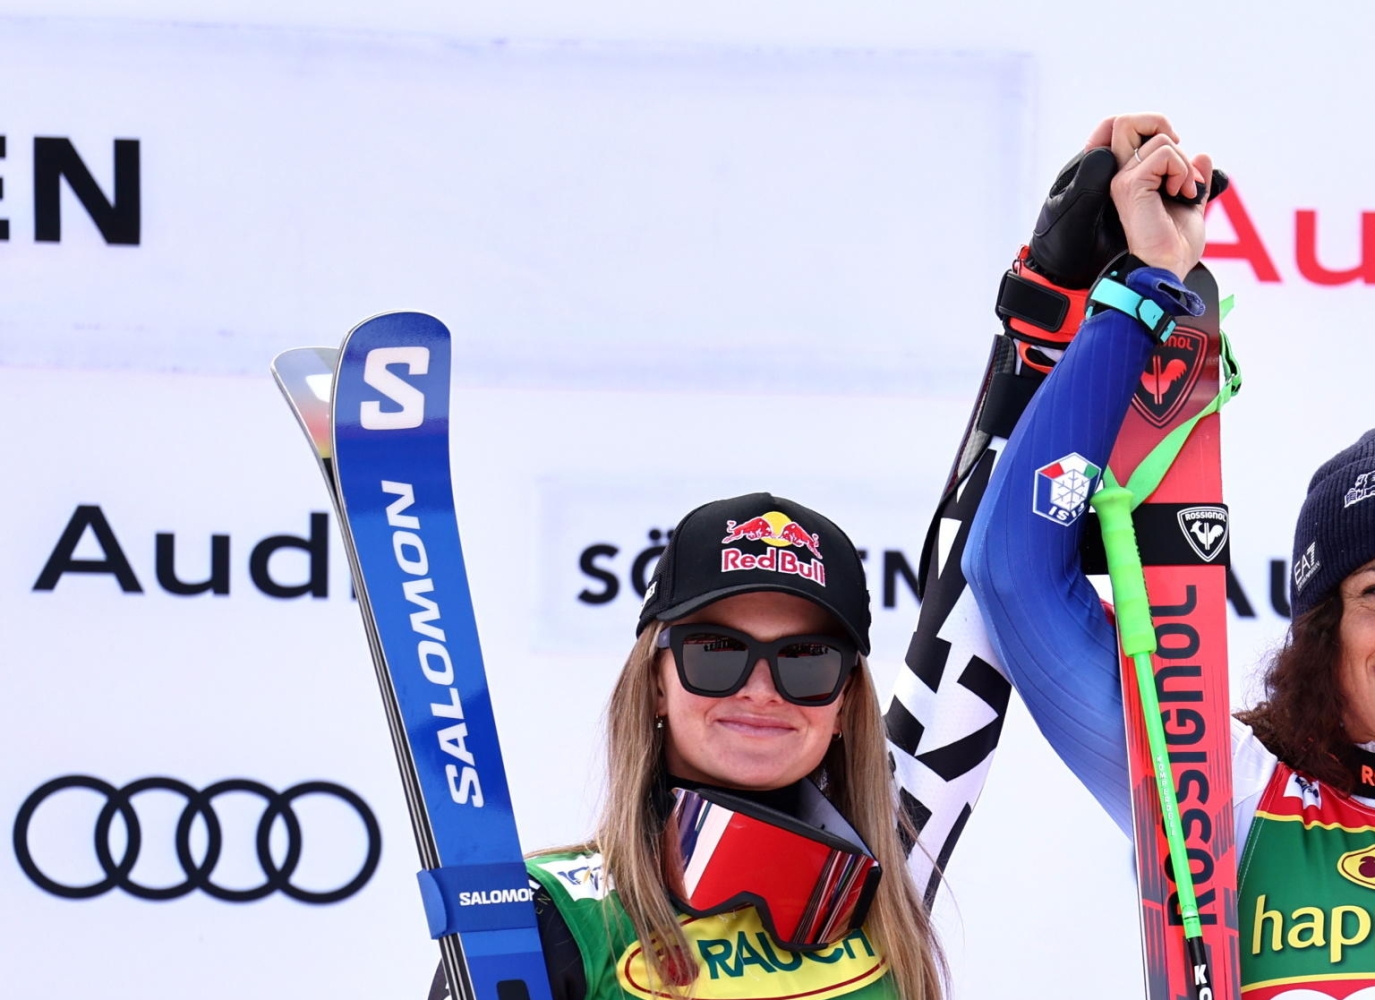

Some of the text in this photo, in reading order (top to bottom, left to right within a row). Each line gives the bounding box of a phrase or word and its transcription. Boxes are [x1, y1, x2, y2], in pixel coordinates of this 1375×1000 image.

[0, 134, 141, 247] N
[32, 504, 358, 602] Aud
[1185, 511, 1228, 522] ROSSIGNOL
[721, 547, 827, 588] Red Bull
[381, 480, 484, 808] SALOMON
